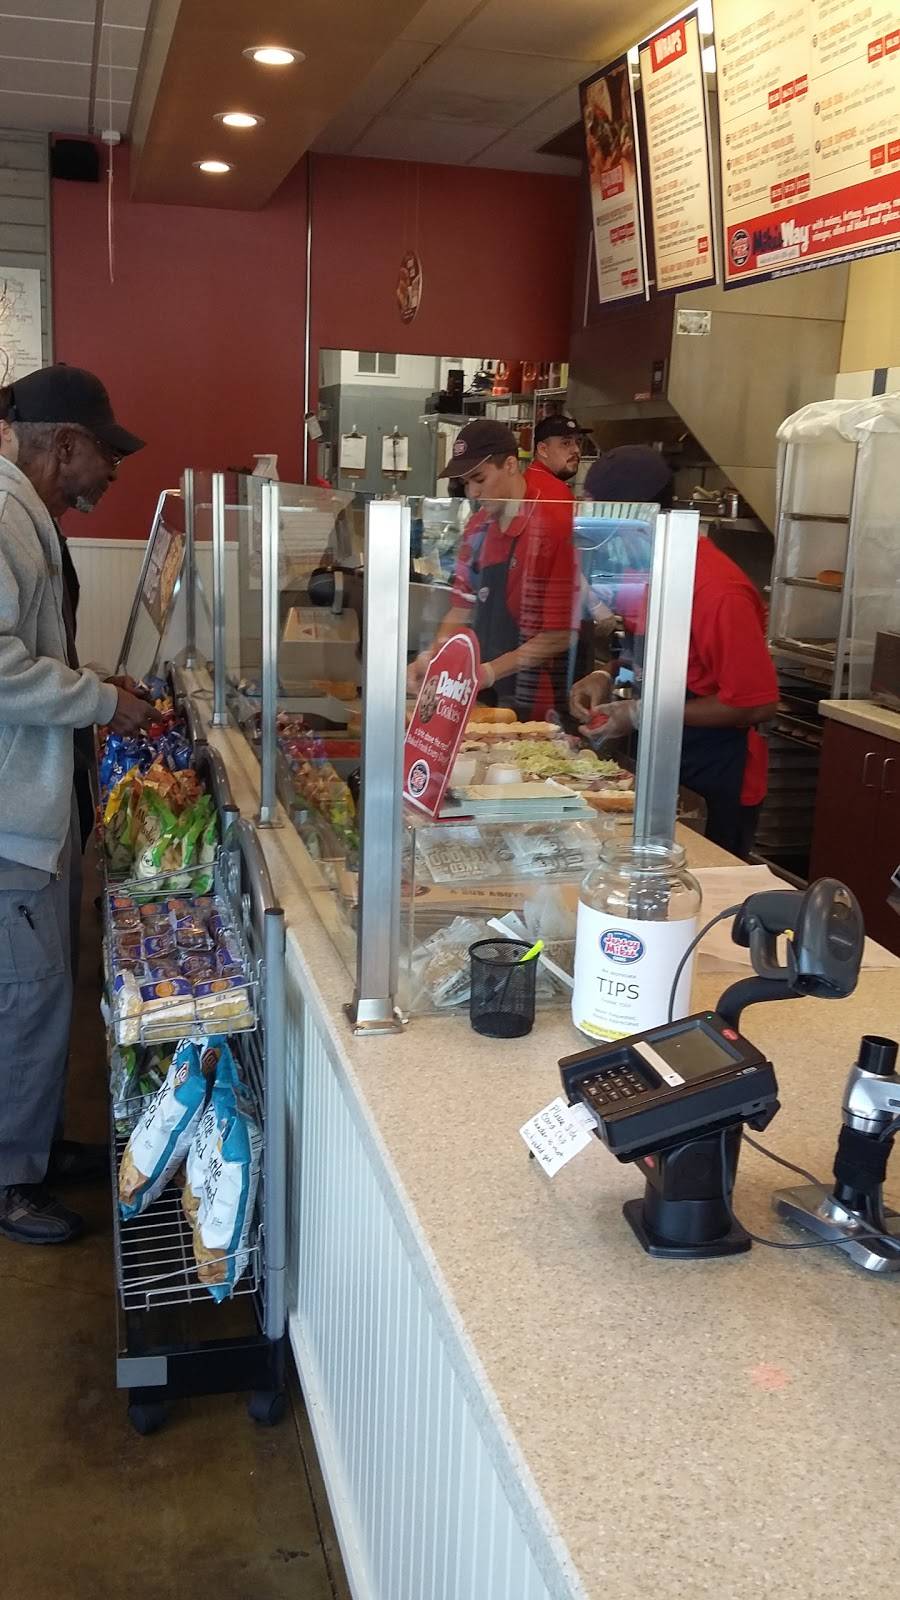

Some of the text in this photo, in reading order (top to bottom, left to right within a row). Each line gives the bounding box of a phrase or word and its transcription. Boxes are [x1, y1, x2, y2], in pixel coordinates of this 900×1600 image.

[781, 219, 811, 253] Way
[436, 670, 472, 706] David's
[436, 698, 460, 724] Cookies
[605, 933, 641, 951] Jersey
[596, 976, 640, 1000] TIPS
